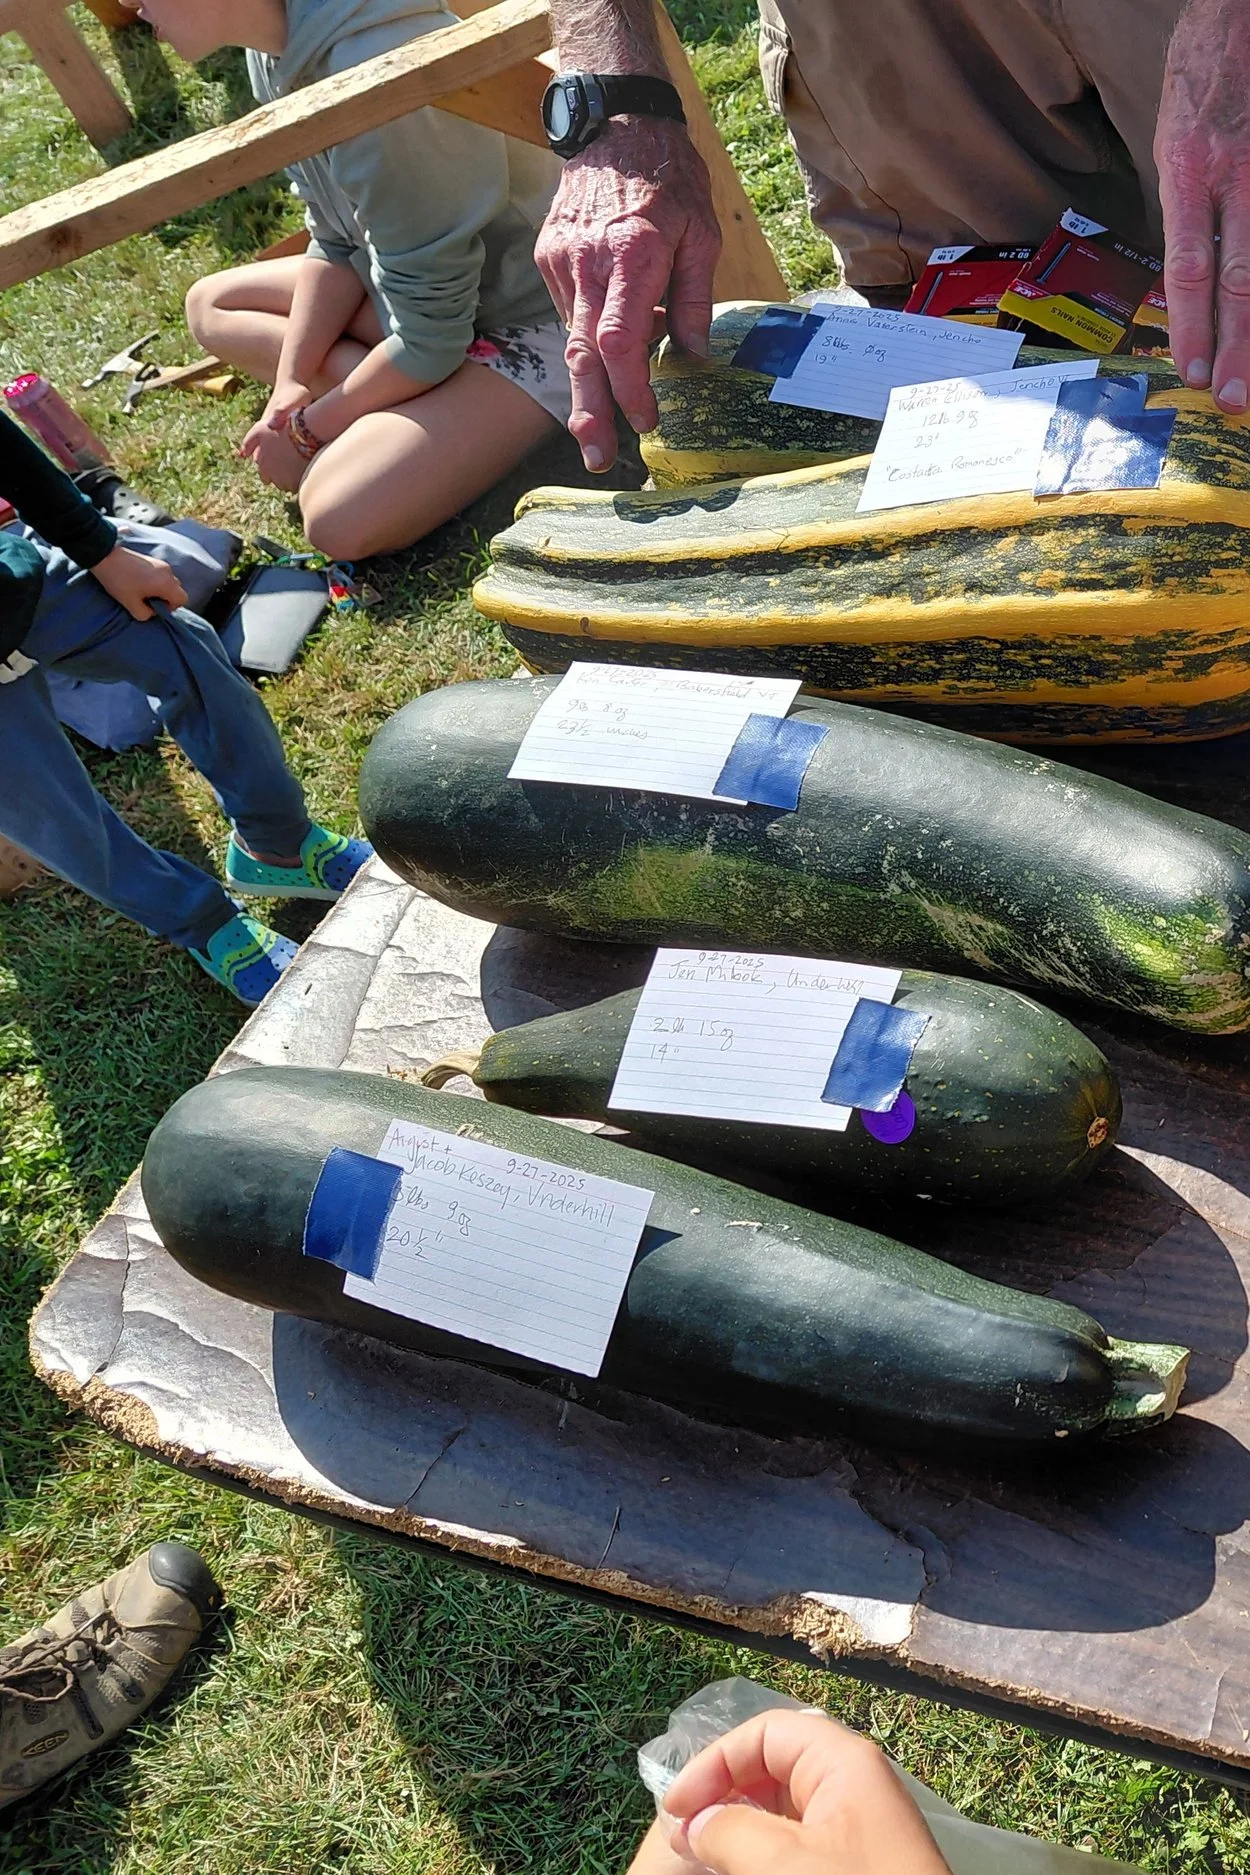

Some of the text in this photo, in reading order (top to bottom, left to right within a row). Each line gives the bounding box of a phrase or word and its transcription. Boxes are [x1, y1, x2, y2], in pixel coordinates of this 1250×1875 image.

[1013, 283, 1037, 300] ACE
[1050, 306, 1076, 324] NAILS
[1074, 318, 1115, 344] COMMON
[506, 1157, 587, 1190] 9-27-2025
